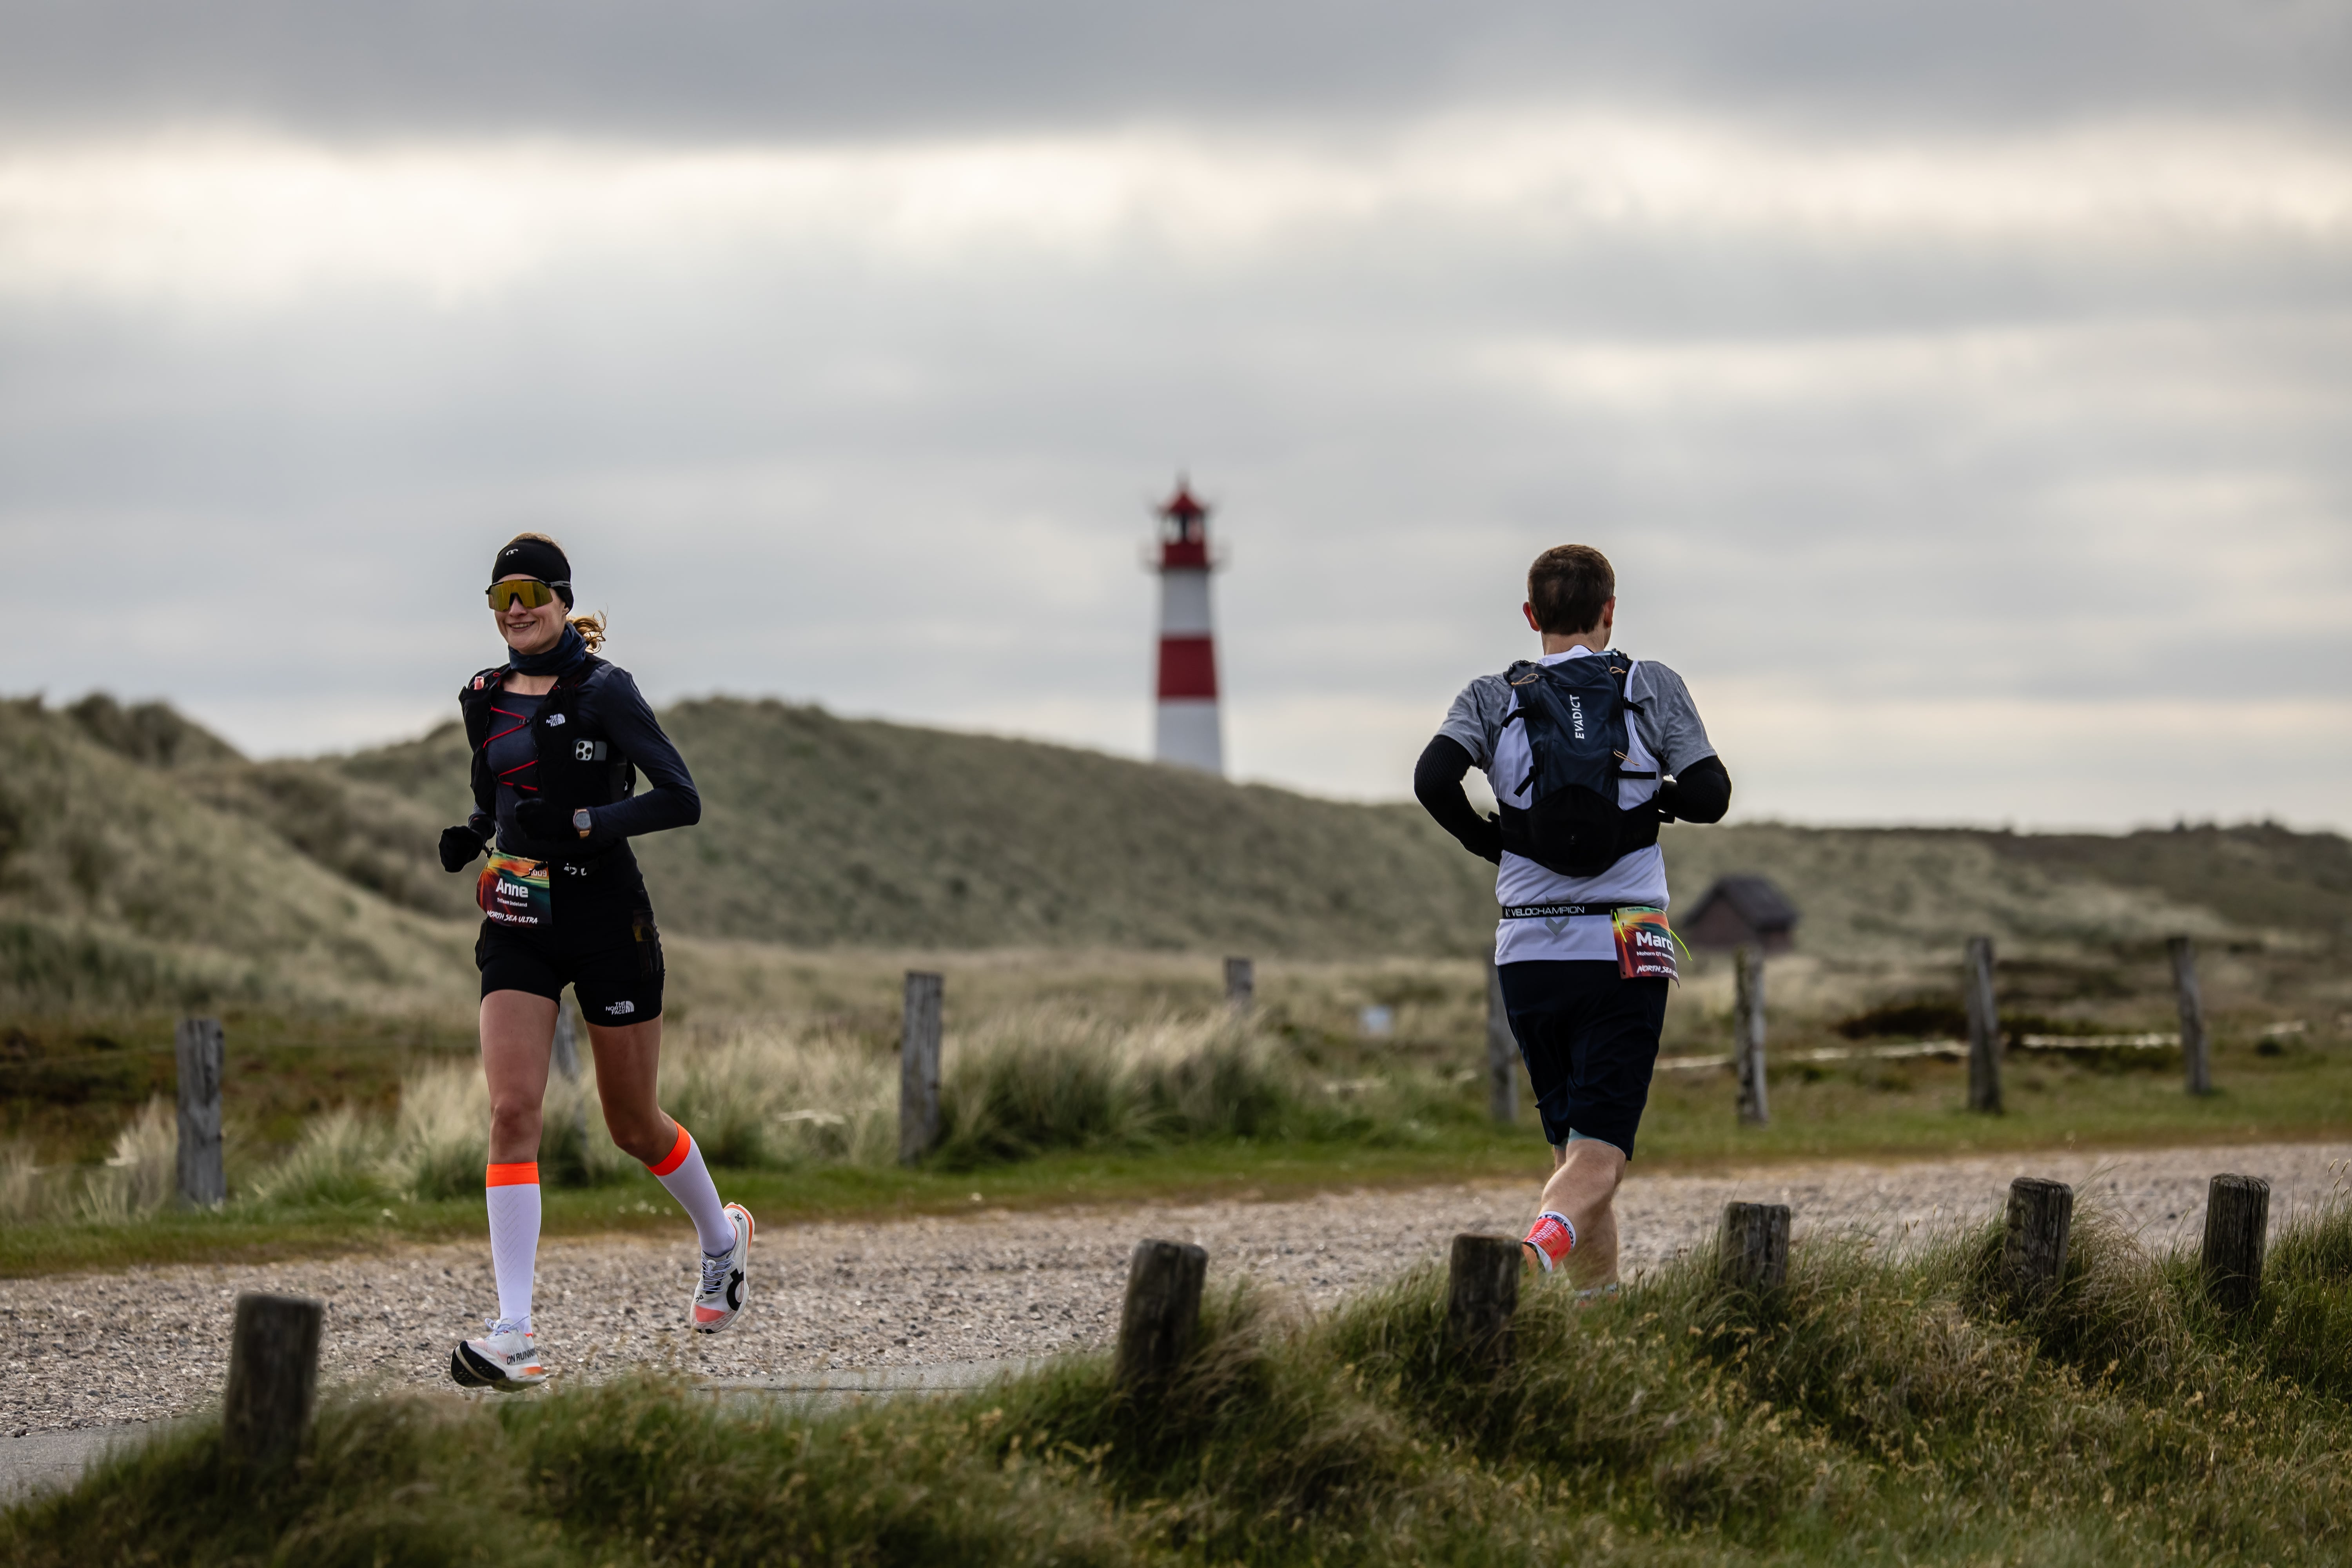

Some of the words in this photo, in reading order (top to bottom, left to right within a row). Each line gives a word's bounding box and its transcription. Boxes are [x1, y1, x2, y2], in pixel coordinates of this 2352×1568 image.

[1570, 694, 1584, 739] EVADICT
[495, 878, 528, 898] Anne
[1511, 906, 1584, 916] VELOCHAMPION
[504, 914, 517, 922] SEA
[518, 916, 538, 924] ULTRA
[1637, 964, 1661, 974] NORTH
[506, 1354, 515, 1365] ON
